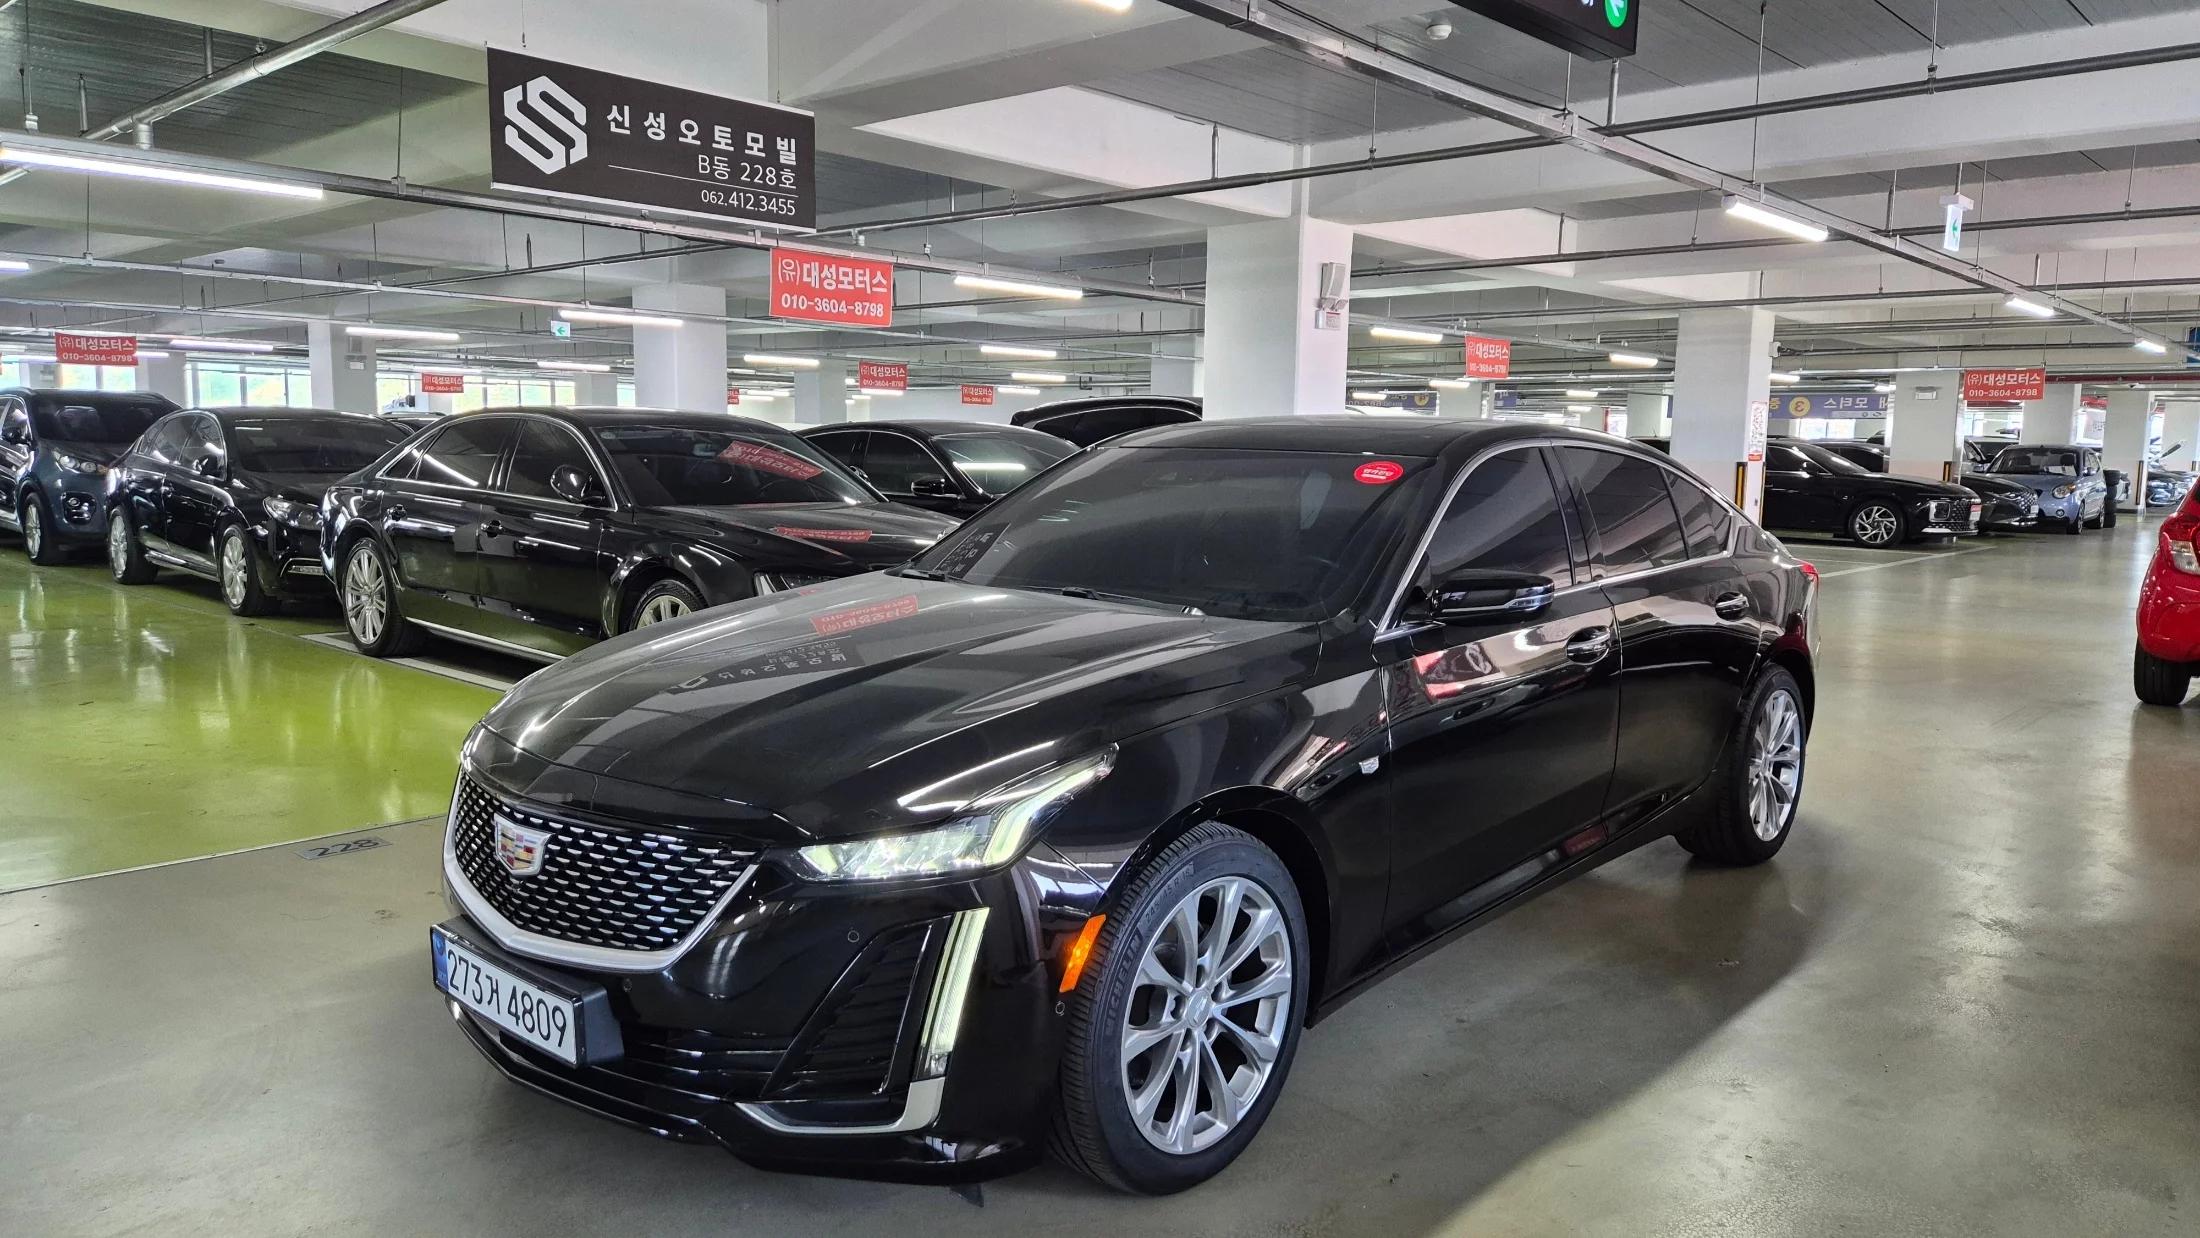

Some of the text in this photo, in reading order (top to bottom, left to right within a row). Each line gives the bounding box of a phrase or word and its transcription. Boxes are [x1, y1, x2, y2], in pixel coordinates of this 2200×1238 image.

[698, 154, 797, 190] B동 228호
[701, 189, 796, 216] 062.412.3455
[778, 256, 888, 295] (유)대성모터스
[781, 293, 884, 318] 010-3604-8798
[59, 336, 134, 351] (유)대성모터스
[62, 352, 132, 362] 010-3604-8798
[1967, 373, 2041, 386] (유)대성모터스
[1968, 388, 2038, 397] 010-3604-8798
[309, 839, 379, 857] 228
[447, 949, 568, 1048] 273거 4809
